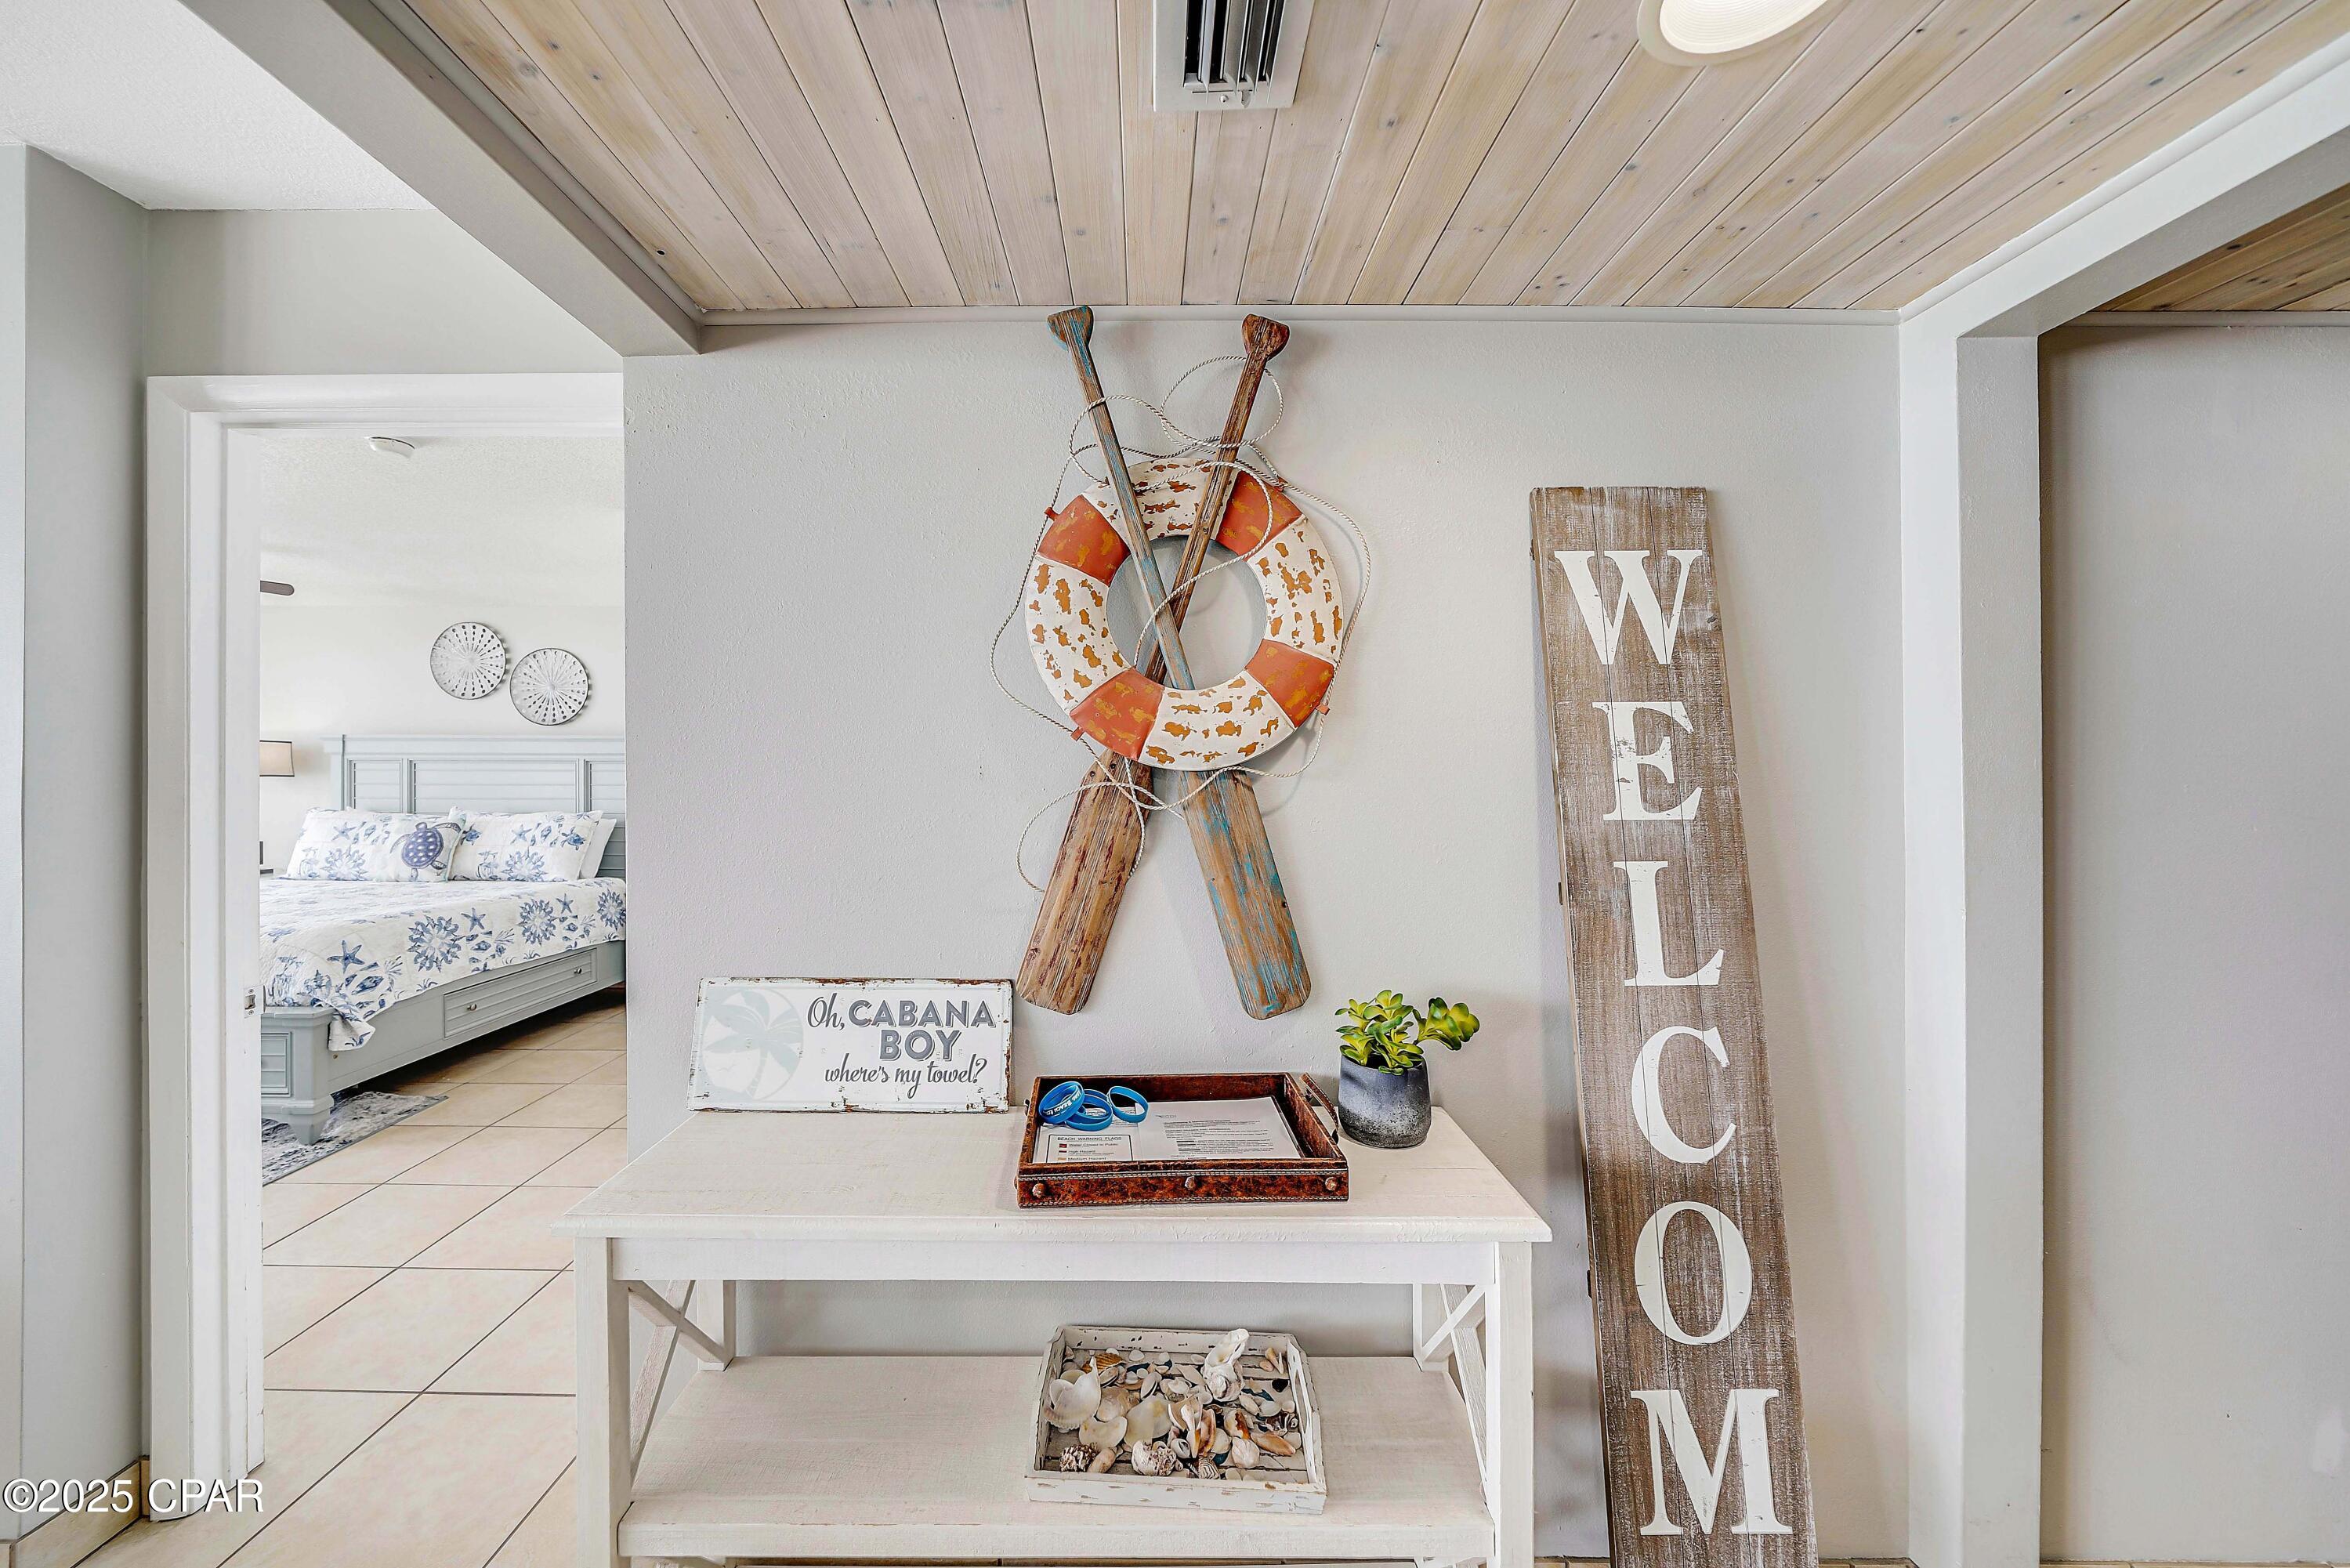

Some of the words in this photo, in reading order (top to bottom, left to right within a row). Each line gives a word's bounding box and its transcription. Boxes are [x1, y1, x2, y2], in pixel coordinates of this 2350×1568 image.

[807, 992, 845, 1030] Oh,
[848, 999, 997, 1028] CABANA
[879, 1030, 961, 1061] BOY
[824, 1052, 889, 1083] where's
[894, 1064, 923, 1099] my
[926, 1054, 987, 1084] towel?
